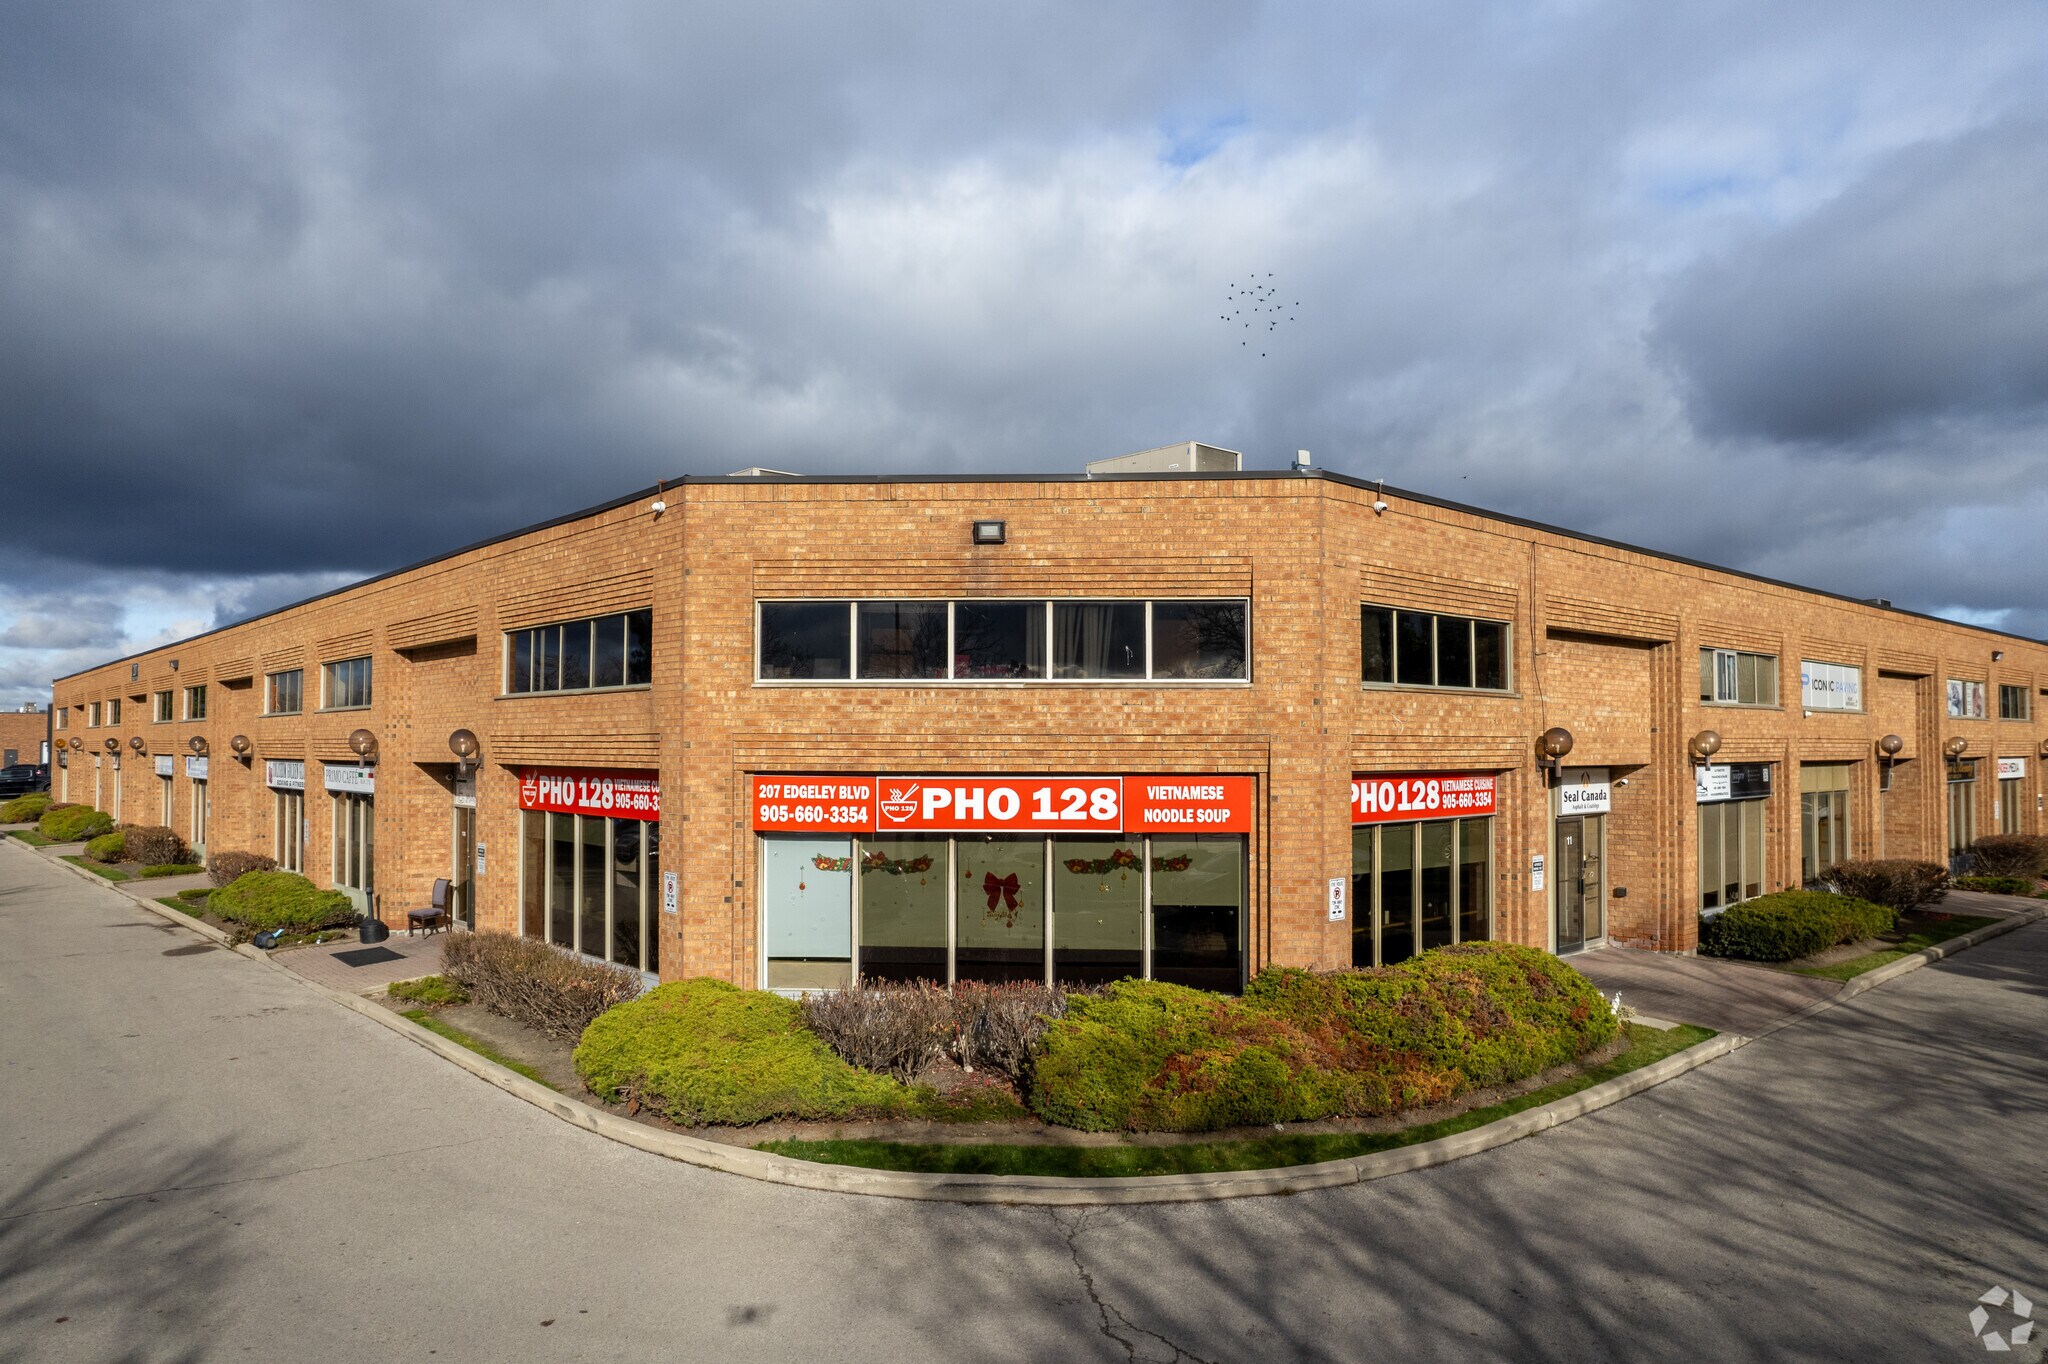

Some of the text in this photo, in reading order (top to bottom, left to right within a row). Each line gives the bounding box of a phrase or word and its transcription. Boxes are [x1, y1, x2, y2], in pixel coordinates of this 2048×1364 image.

[1812, 679, 1857, 694] ICONIC PAVING
[326, 768, 358, 784] PRIMO CAFFÉ
[539, 775, 614, 809] PHO 128
[614, 778, 650, 792] VIETNAMESE
[759, 784, 870, 800] 207 EDGELEY BLVD
[1441, 778, 1493, 792] VIETNAMESE CUISINE
[1147, 786, 1224, 800] VIETNAMESE
[1397, 780, 1440, 811] 128
[1442, 792, 1491, 809] 905-660-3354
[1564, 789, 1607, 802] Seal Canada
[922, 787, 1118, 820] PHO 128
[760, 804, 868, 824] 905-660-3354
[1144, 809, 1231, 823] NOODLE SOUP
[1566, 835, 1573, 845] 11
